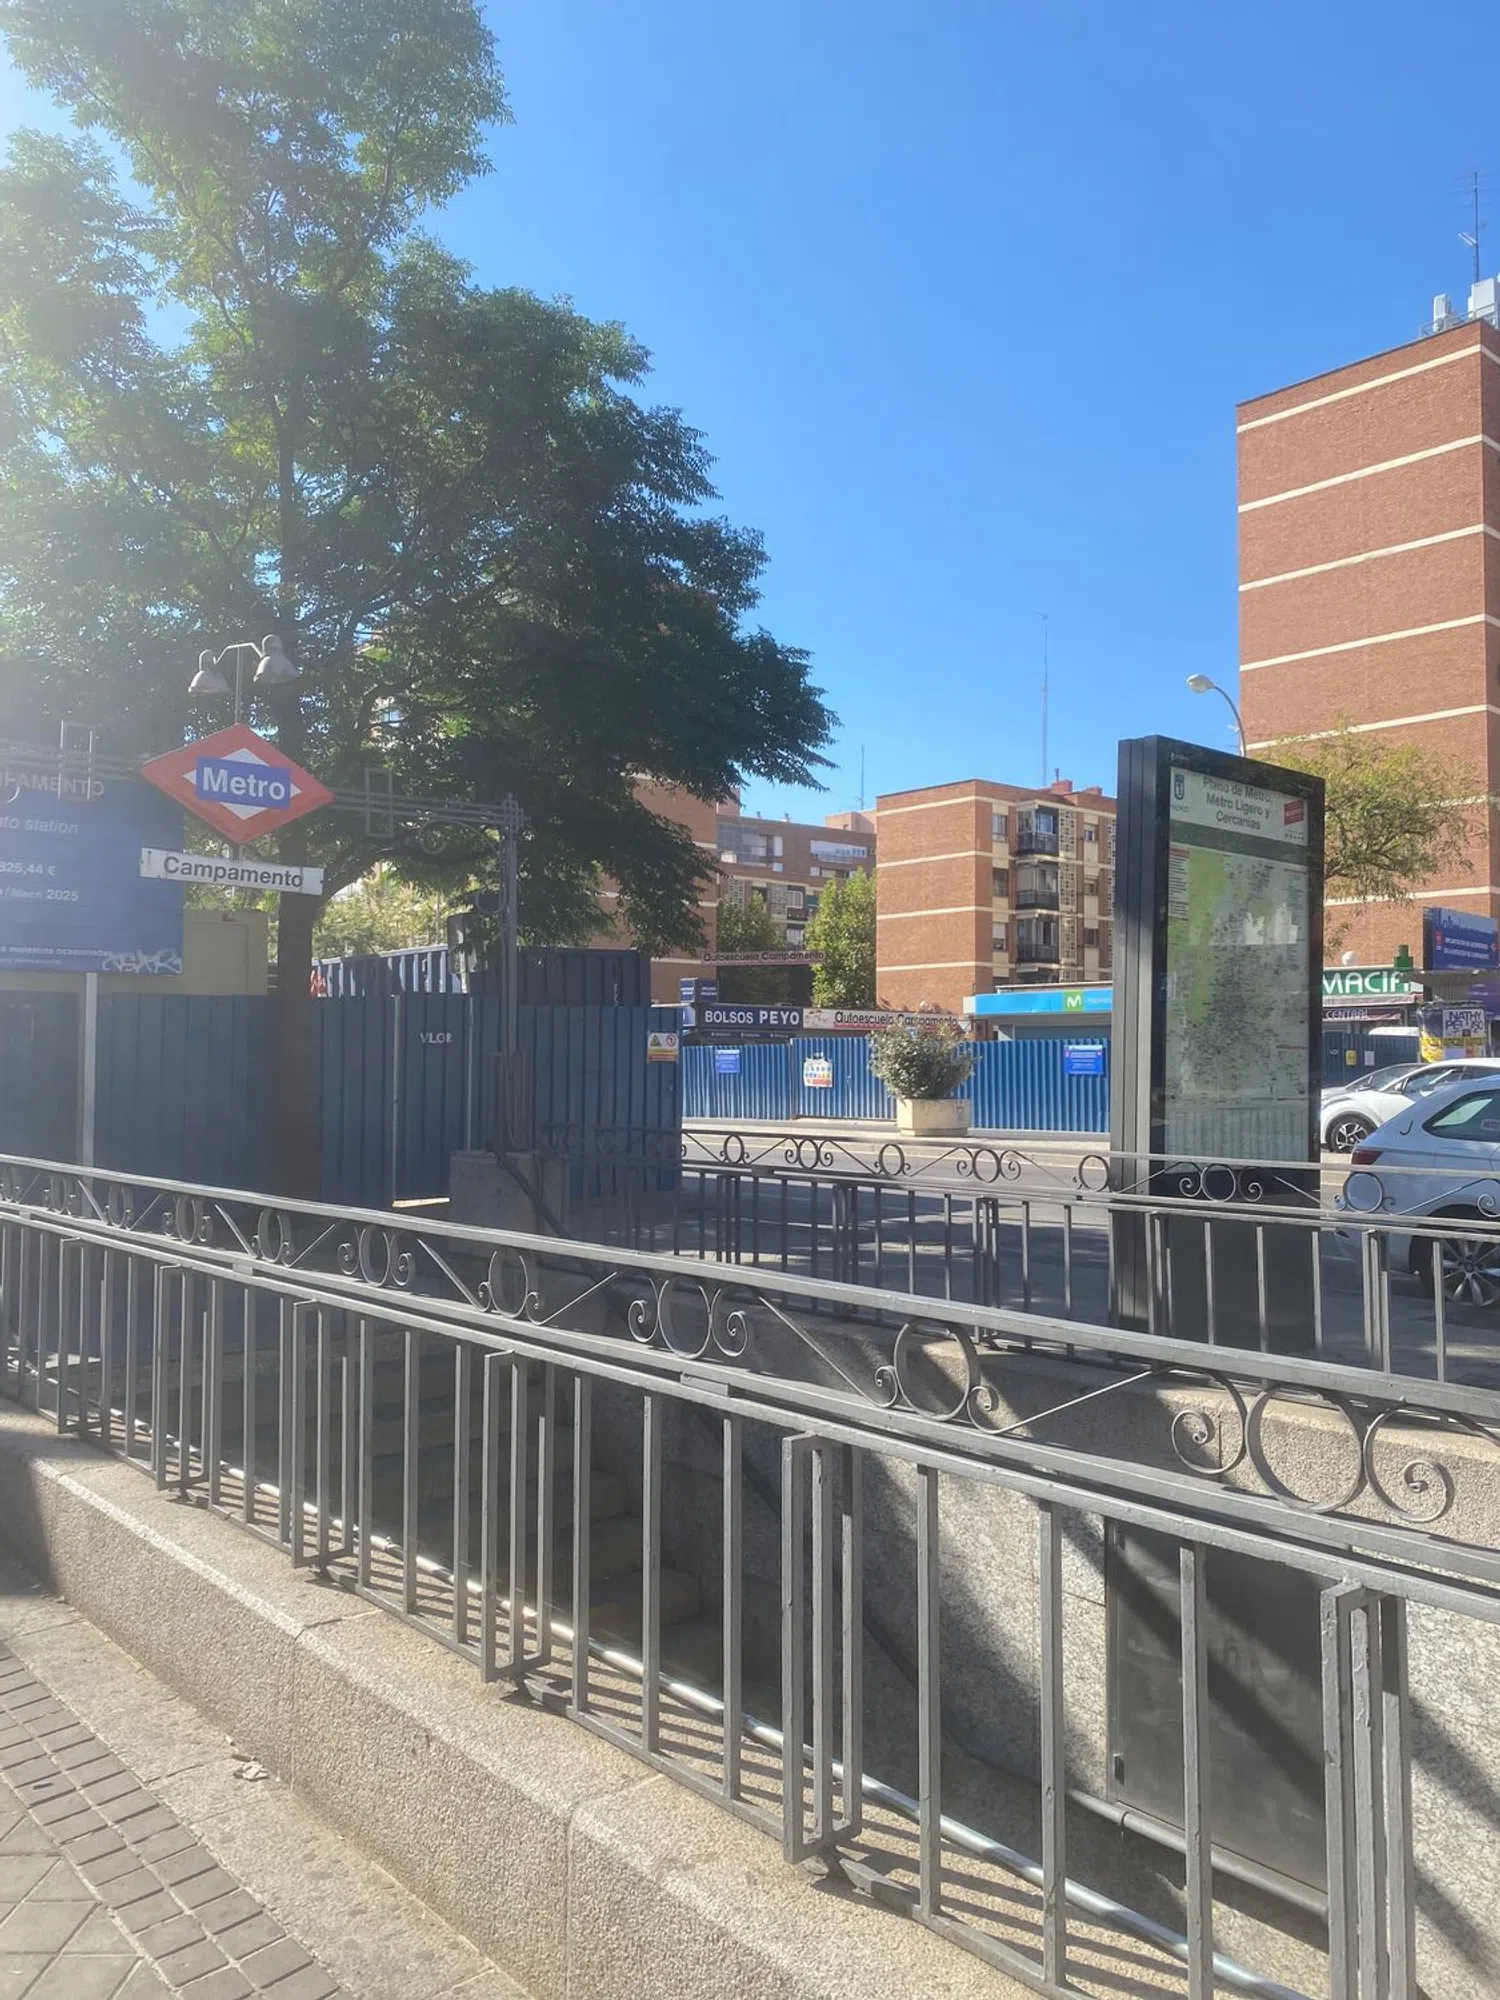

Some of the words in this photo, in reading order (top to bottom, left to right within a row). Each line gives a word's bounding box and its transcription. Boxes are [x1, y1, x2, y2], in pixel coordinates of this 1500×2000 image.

[202, 766, 286, 801] Metro
[1203, 777, 1229, 793] Plano
[1232, 784, 1243, 796] de
[1206, 792, 1233, 809] Metro
[1236, 801, 1264, 817] Ligero
[1263, 808, 1271, 820] y
[25, 820, 80, 834] station
[164, 856, 304, 888] Campamento
[47, 888, 80, 902] 2025
[704, 1010, 754, 1024] BOLSOS
[759, 1010, 800, 1025] PEYO
